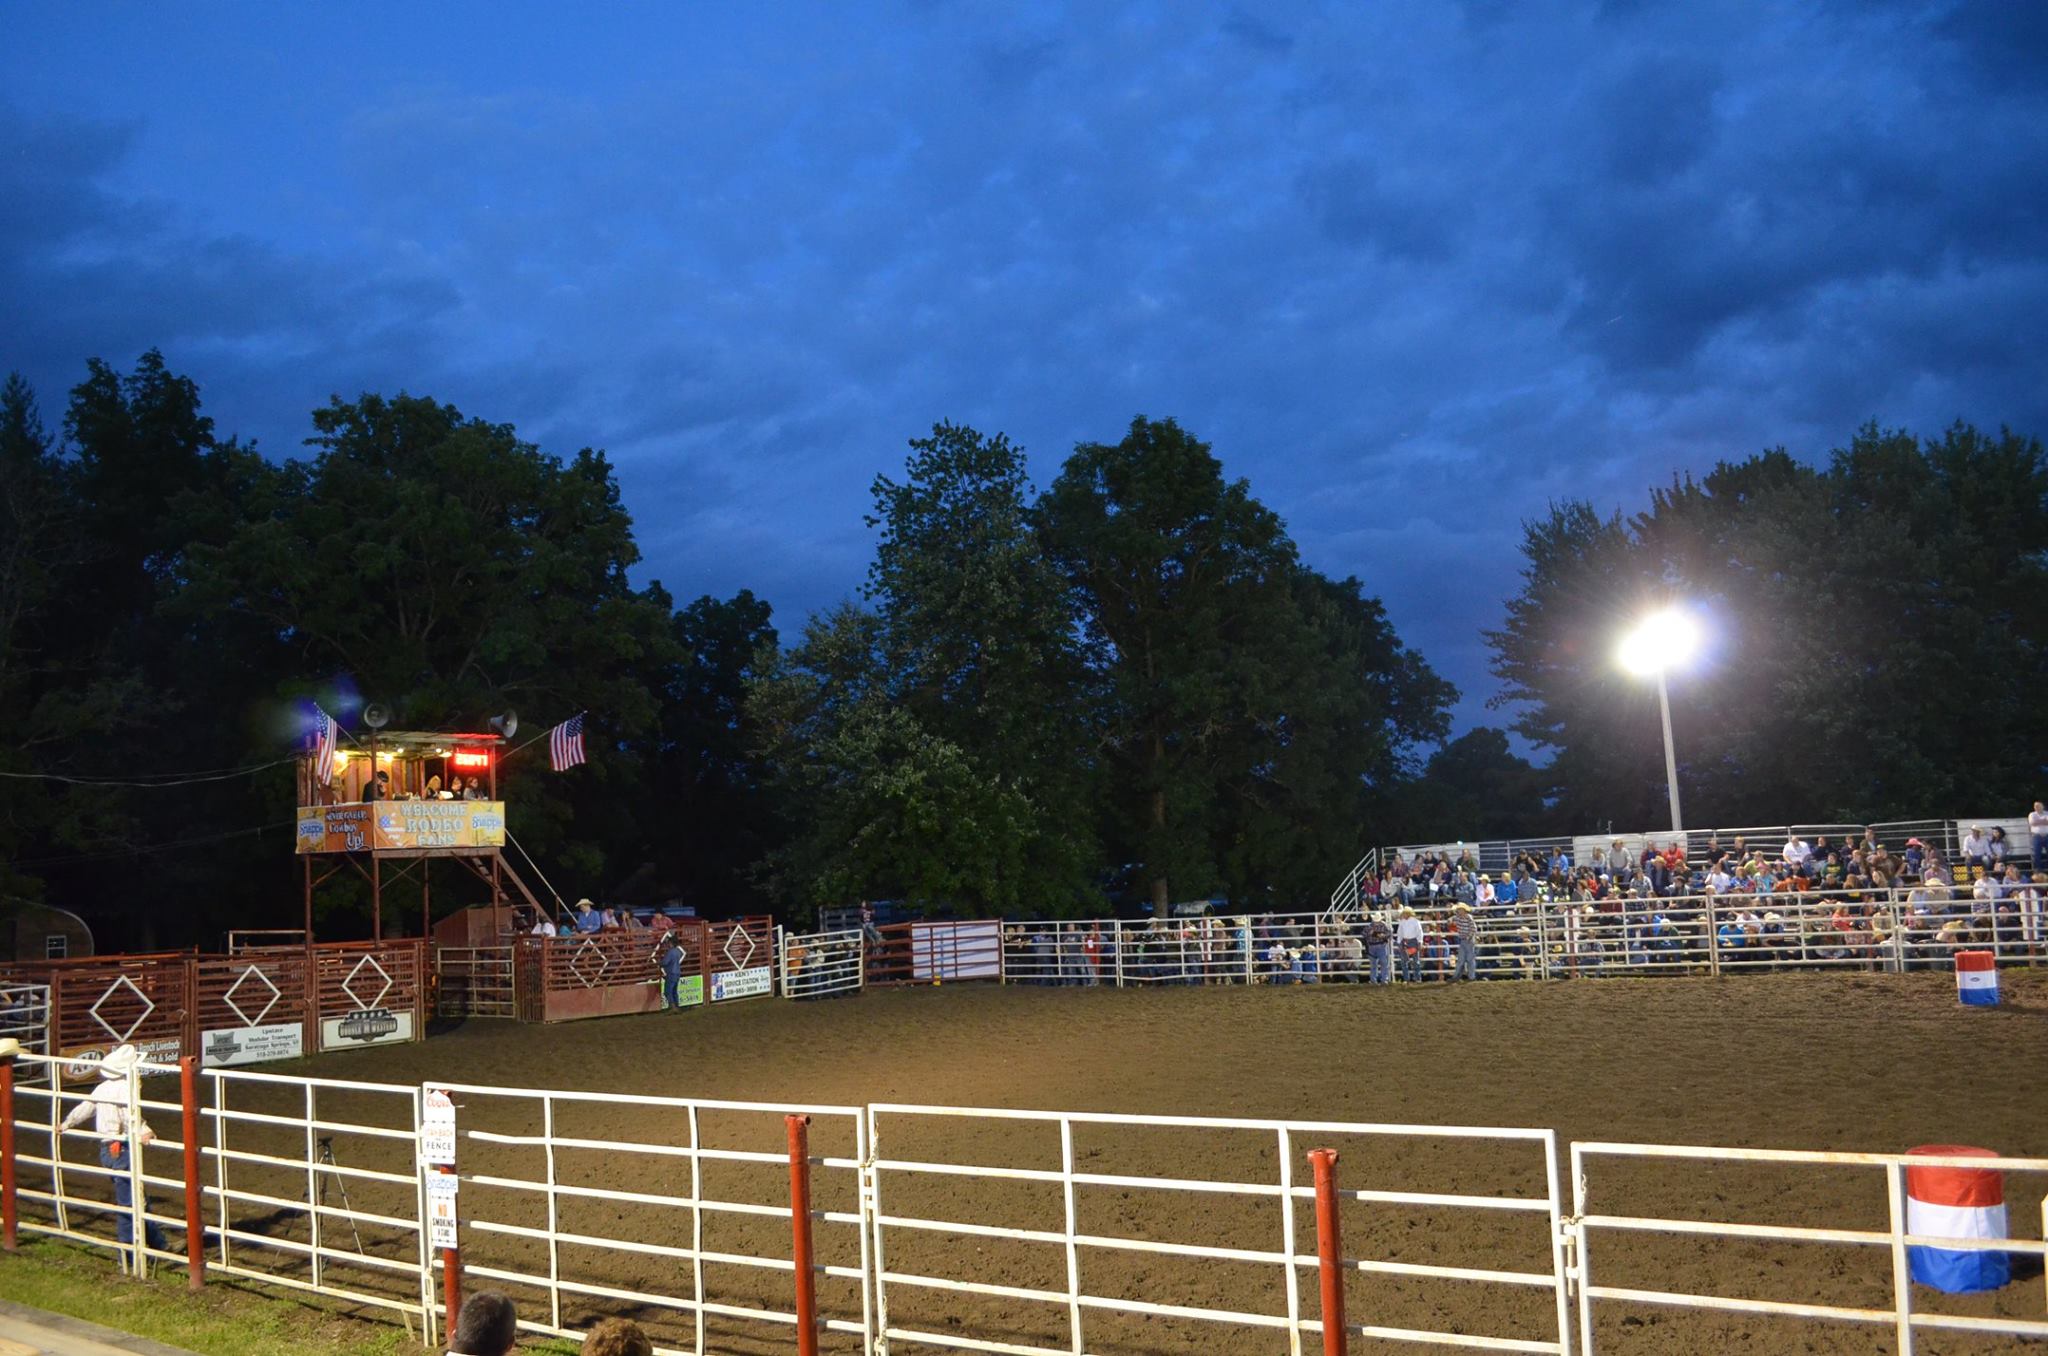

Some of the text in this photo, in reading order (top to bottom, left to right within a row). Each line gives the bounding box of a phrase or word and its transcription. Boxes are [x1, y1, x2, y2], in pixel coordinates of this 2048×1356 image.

[402, 803, 467, 816] WELCOME
[406, 818, 464, 833] RODEO
[417, 834, 456, 846] FANS
[157, 1039, 180, 1052] Livestock
[165, 1052, 179, 1062] Sold
[426, 1141, 452, 1151] FENCE
[438, 1203, 447, 1217] NO
[432, 1217, 454, 1228] SMOKING
